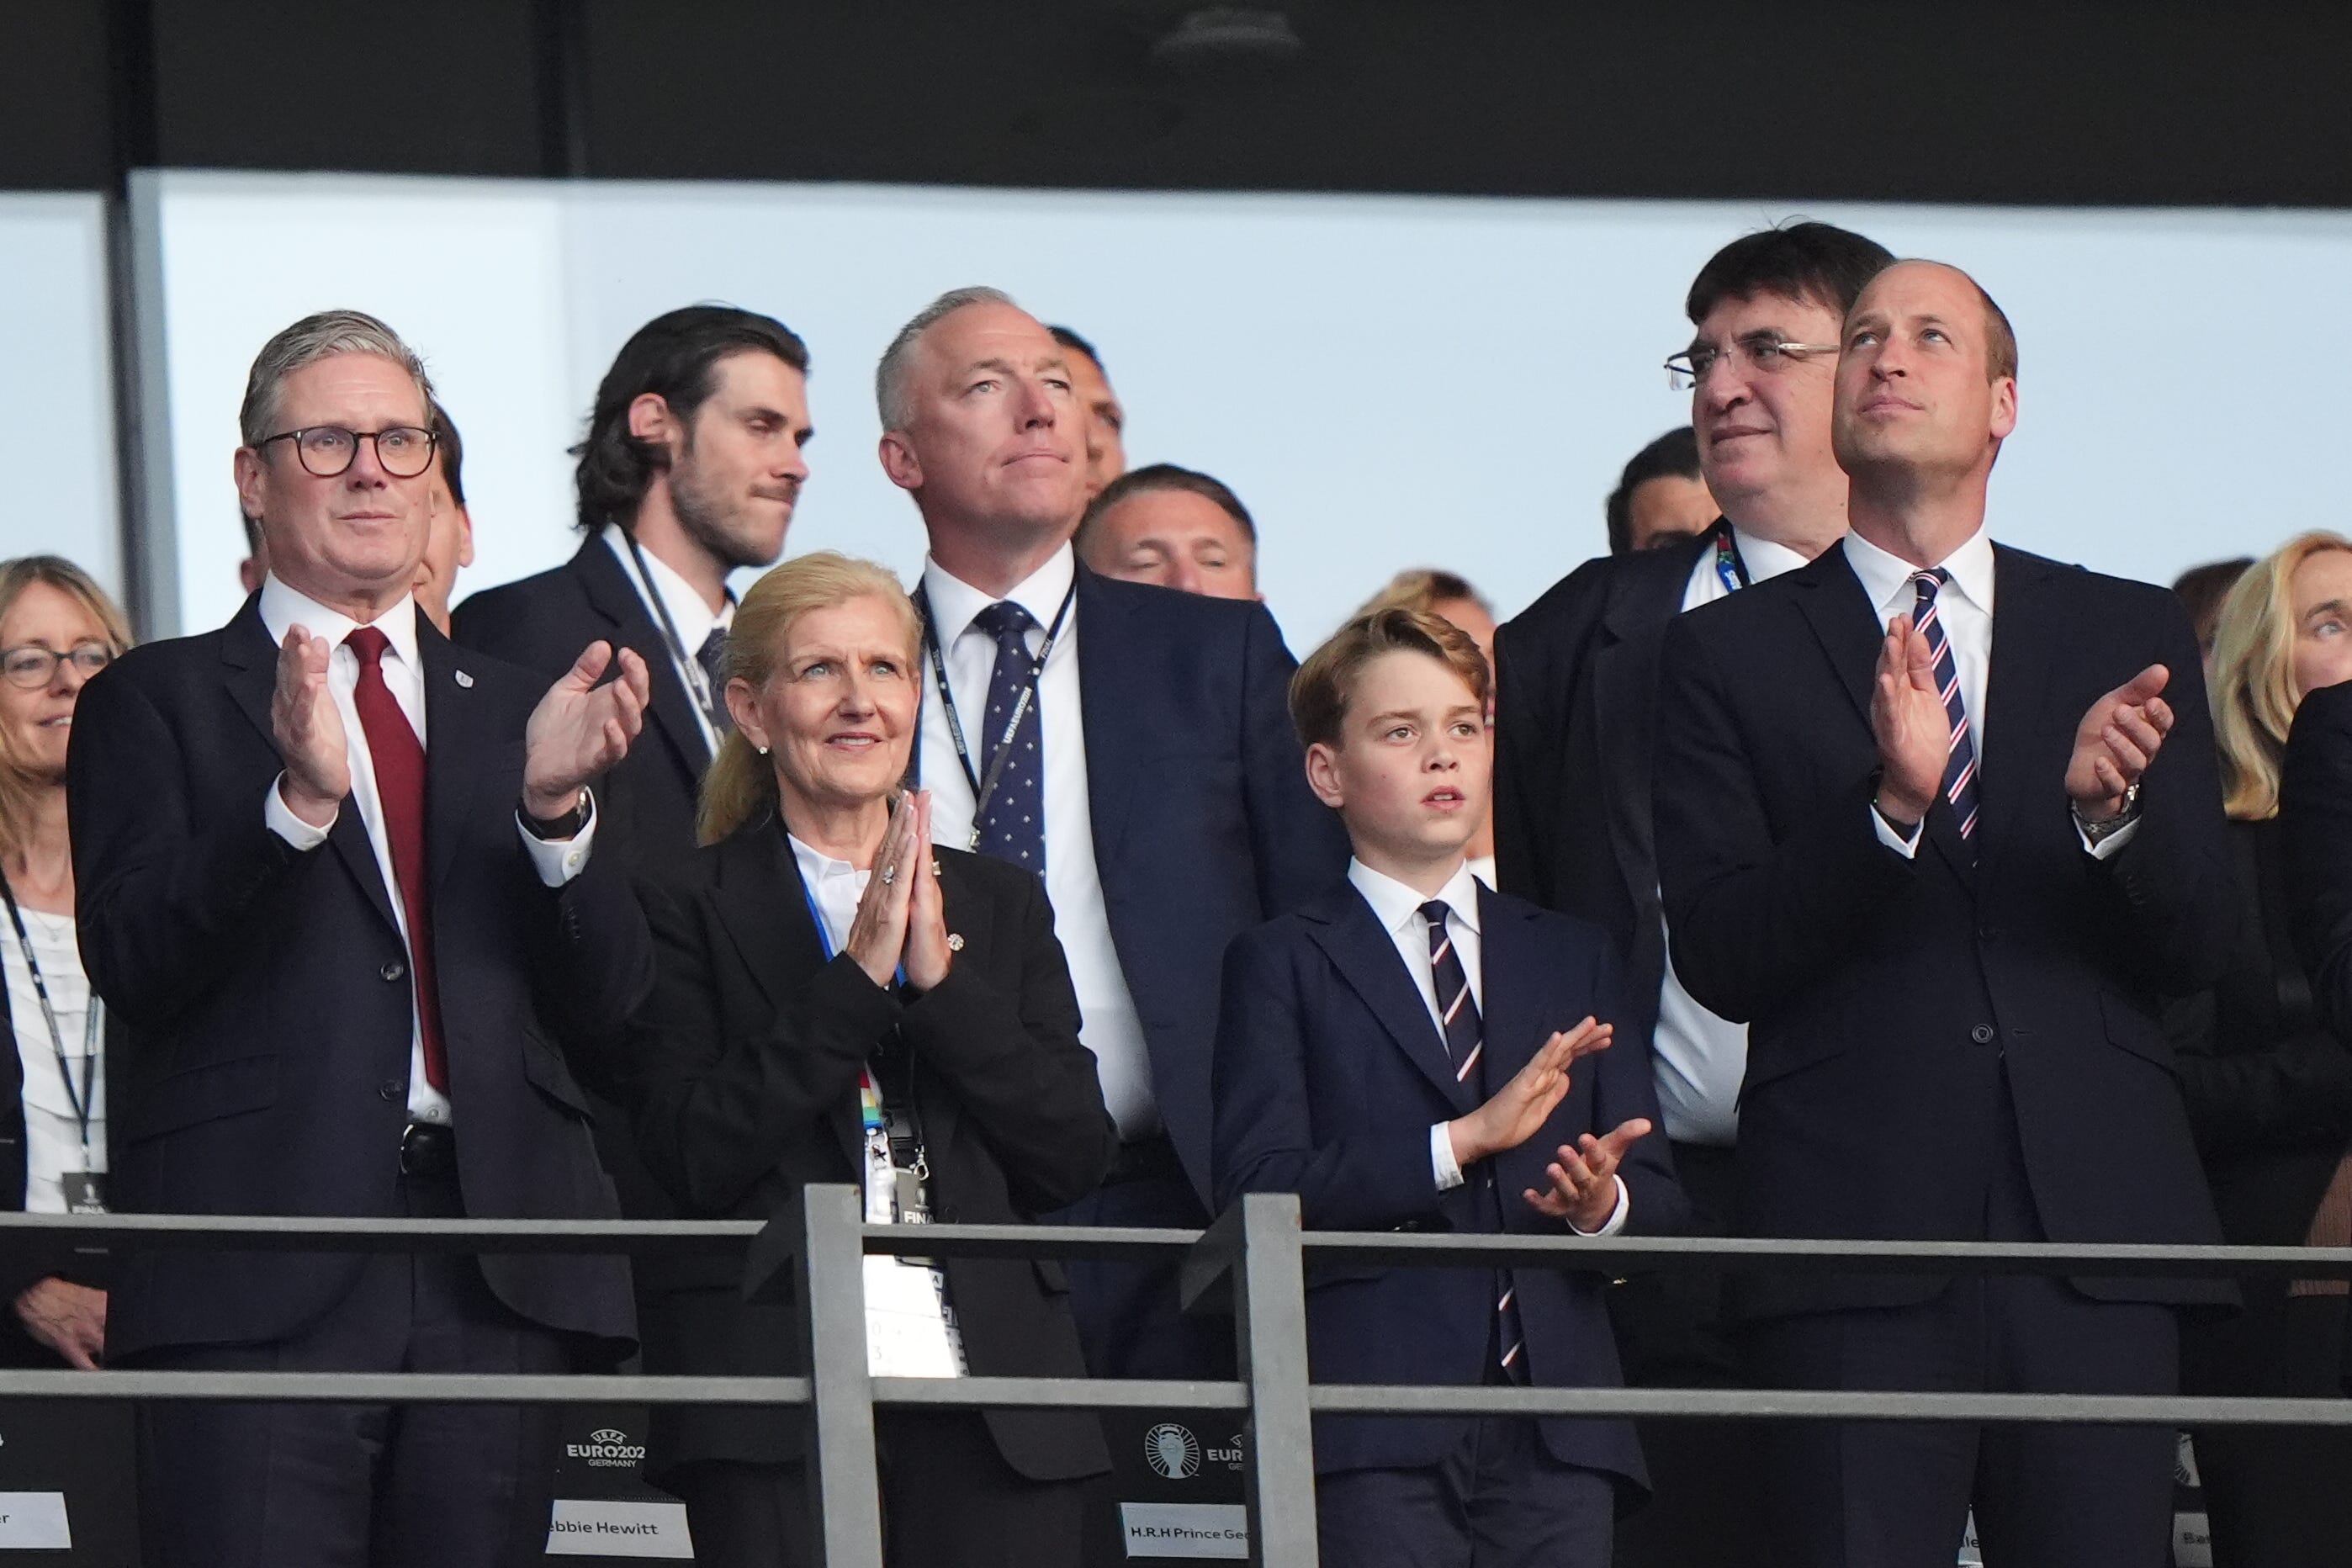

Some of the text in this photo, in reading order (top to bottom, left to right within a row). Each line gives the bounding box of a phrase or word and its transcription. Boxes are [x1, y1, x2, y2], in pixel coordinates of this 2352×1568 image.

[592, 1431, 623, 1444] UEFA
[1206, 1449, 1243, 1461] EUR
[588, 1459, 637, 1468] GERMANY
[0, 1514, 10, 1524] r
[596, 1521, 660, 1535] Hewitt
[1131, 1527, 1171, 1538] H.R.H
[1173, 1527, 1221, 1539] Prince
